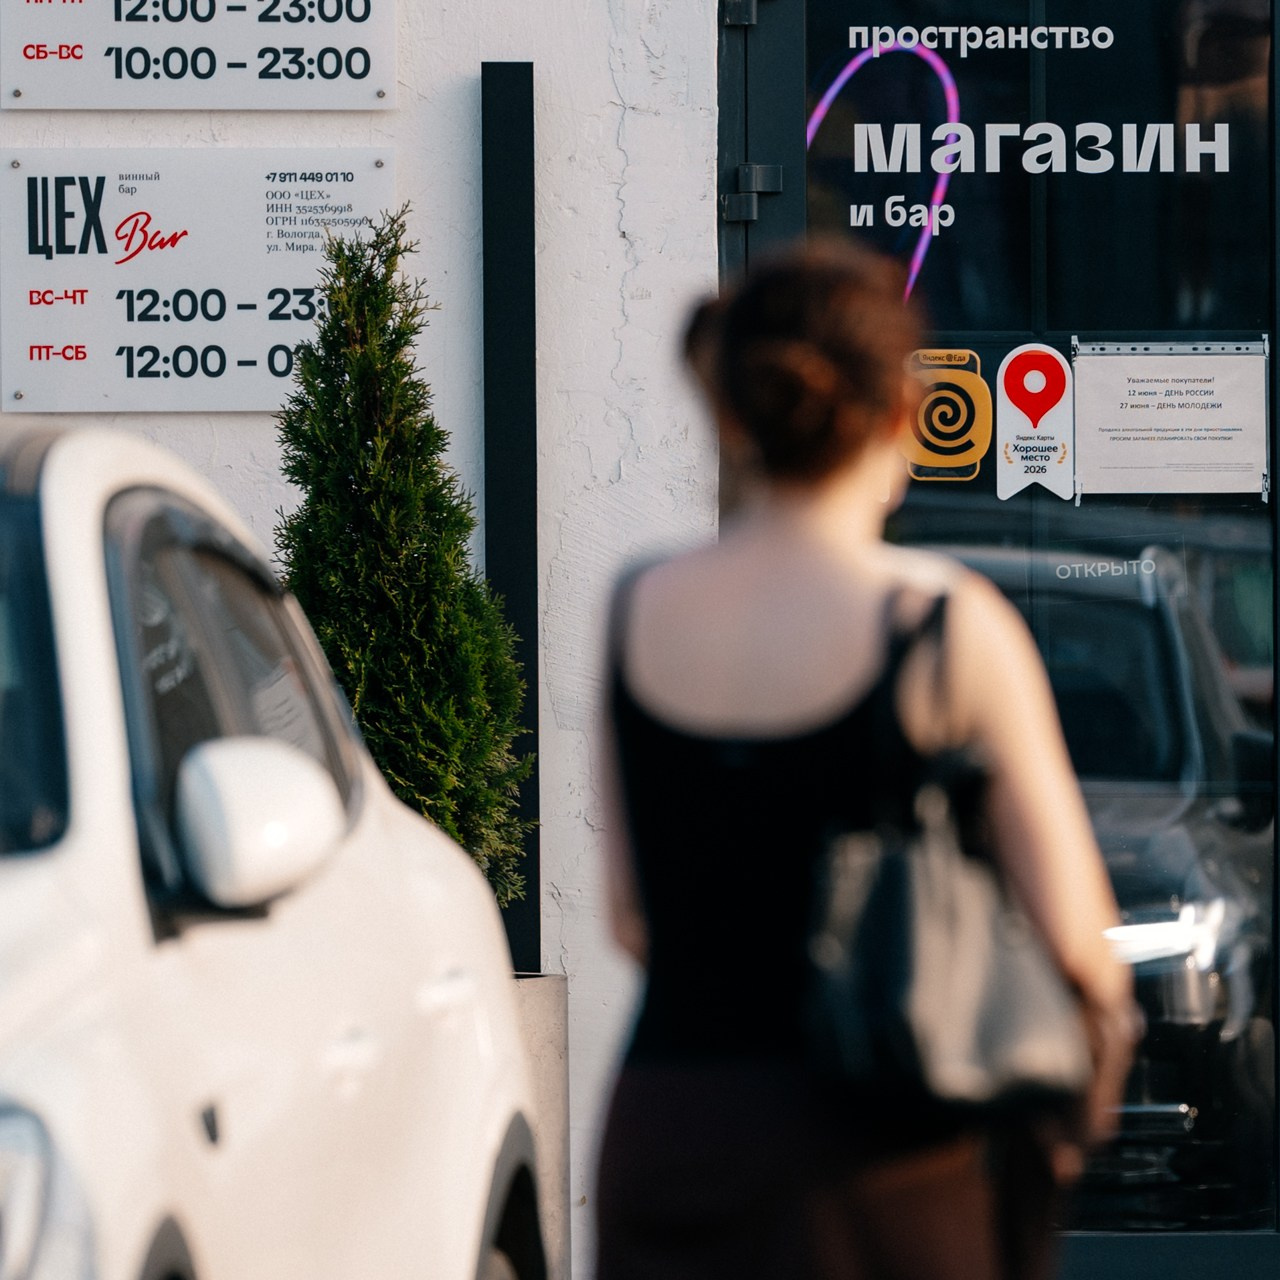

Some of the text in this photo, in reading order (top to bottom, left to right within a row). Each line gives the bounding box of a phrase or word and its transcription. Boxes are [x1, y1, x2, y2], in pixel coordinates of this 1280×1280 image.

[848, 25, 1115, 58] пространство
[104, 46, 217, 80] 10:00
[257, 46, 371, 80] 23:00
[853, 122, 1230, 174] магазин
[118, 172, 160, 181] винный
[265, 172, 354, 182] +7 911 449 01 10
[118, 184, 137, 196] бар
[265, 190, 331, 201] ООО «ЦЕХ»
[266, 203, 353, 215] ИНН 3525369918
[27, 176, 108, 260] ЦЕХ
[265, 216, 297, 226] ОГРН
[849, 195, 956, 236] и бар
[114, 211, 188, 265] Bar
[266, 245, 281, 255] ул.
[116, 288, 227, 322] 12:00
[116, 344, 227, 378] 12:00
[1171, 376, 1215, 385] покупатели!
[1012, 444, 1058, 454] Хорошее
[1024, 465, 1047, 474] 2026
[1056, 559, 1156, 580] ОТКРЫТО
